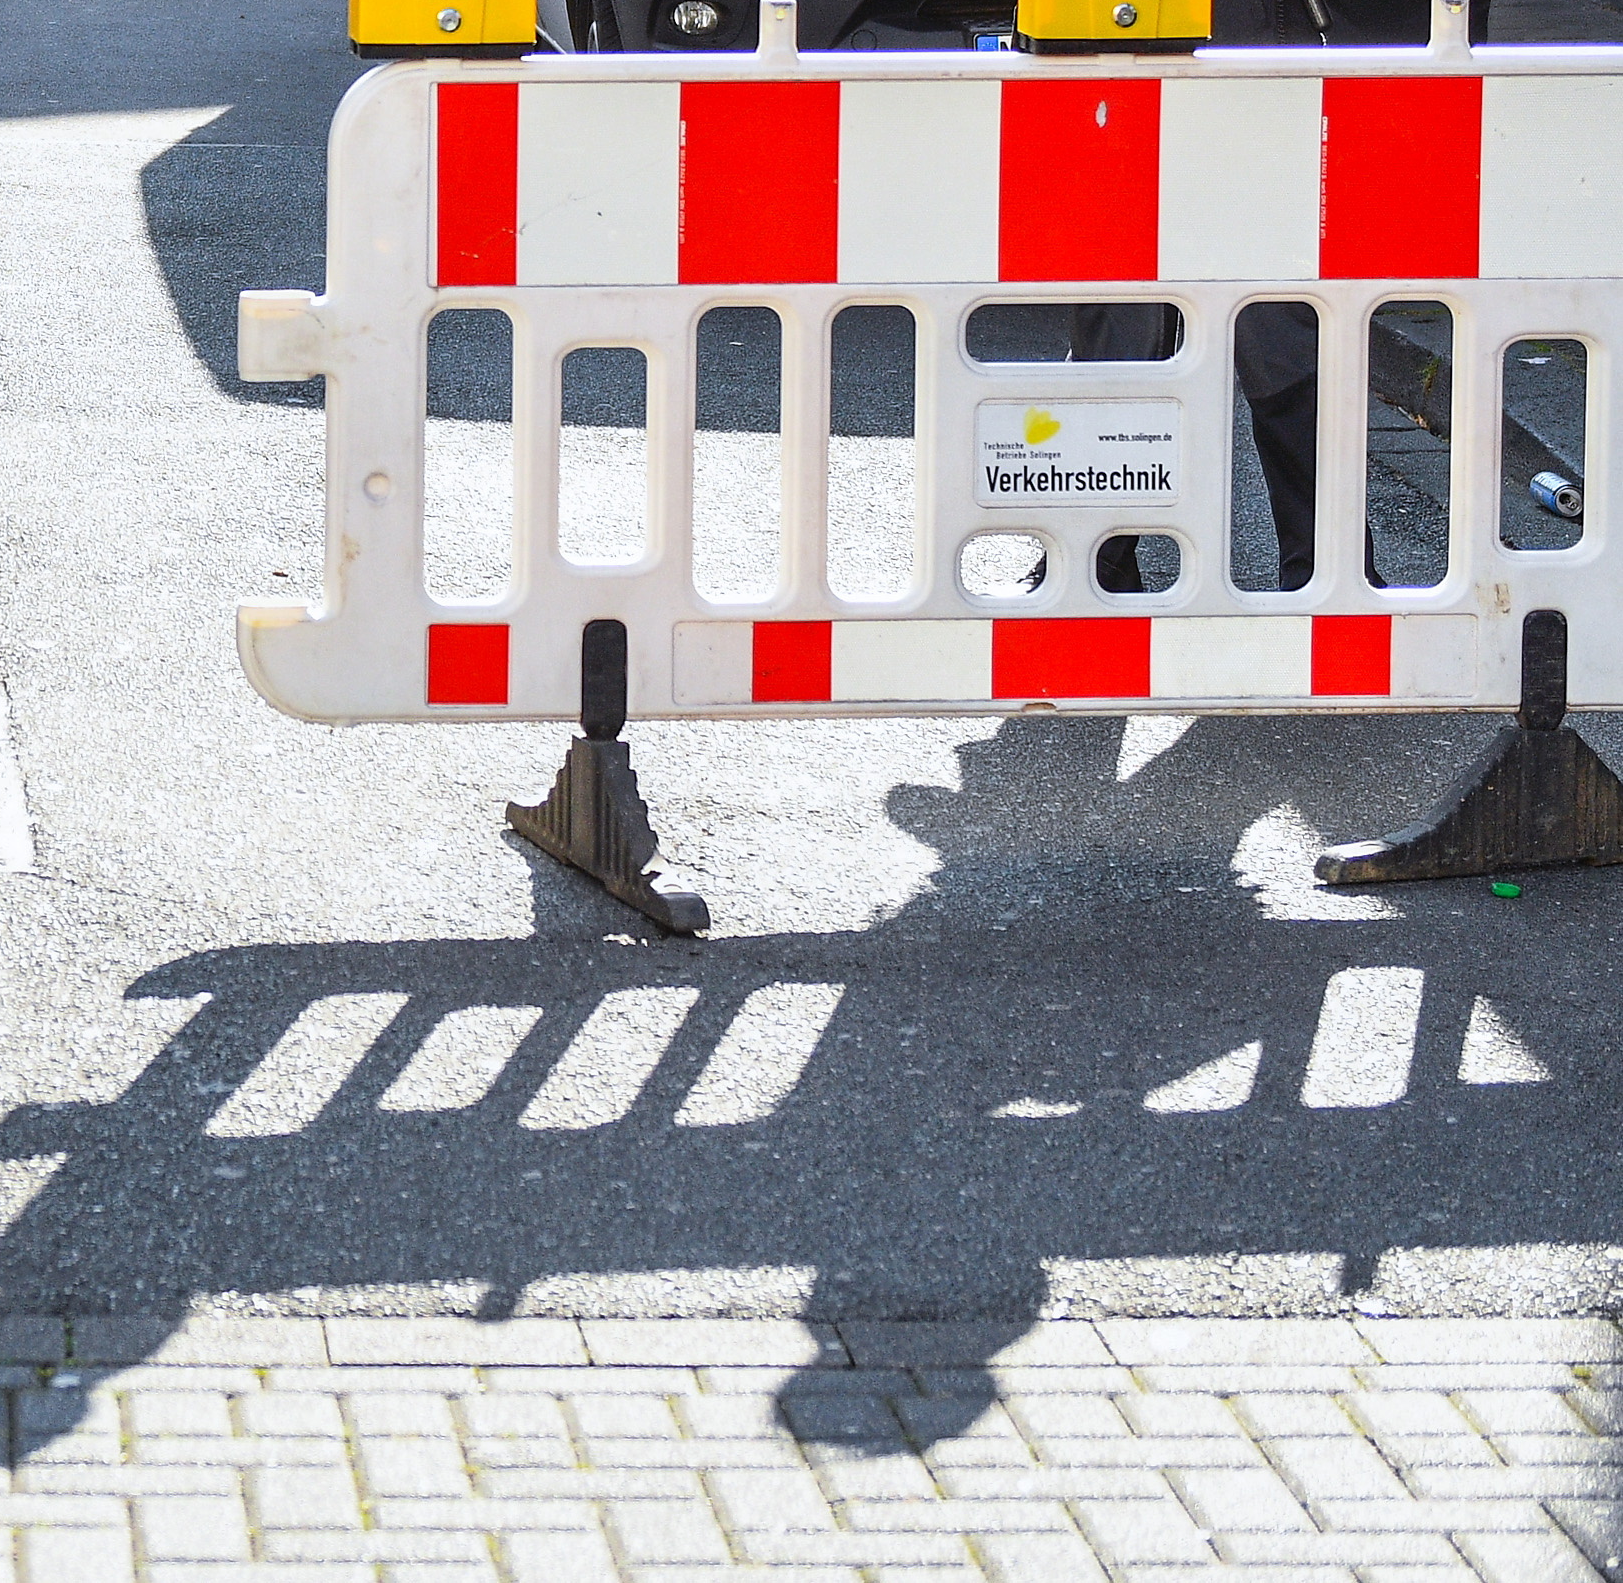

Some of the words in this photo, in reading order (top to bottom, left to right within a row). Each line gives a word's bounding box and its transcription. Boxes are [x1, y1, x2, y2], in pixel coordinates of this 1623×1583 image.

[1098, 432, 1173, 444] www.tbs.solingen.de
[983, 441, 1024, 450] Technische
[996, 451, 1027, 460] Betriebe
[1029, 450, 1062, 461] Solingen
[985, 463, 1173, 493] Verkehrstechnik
